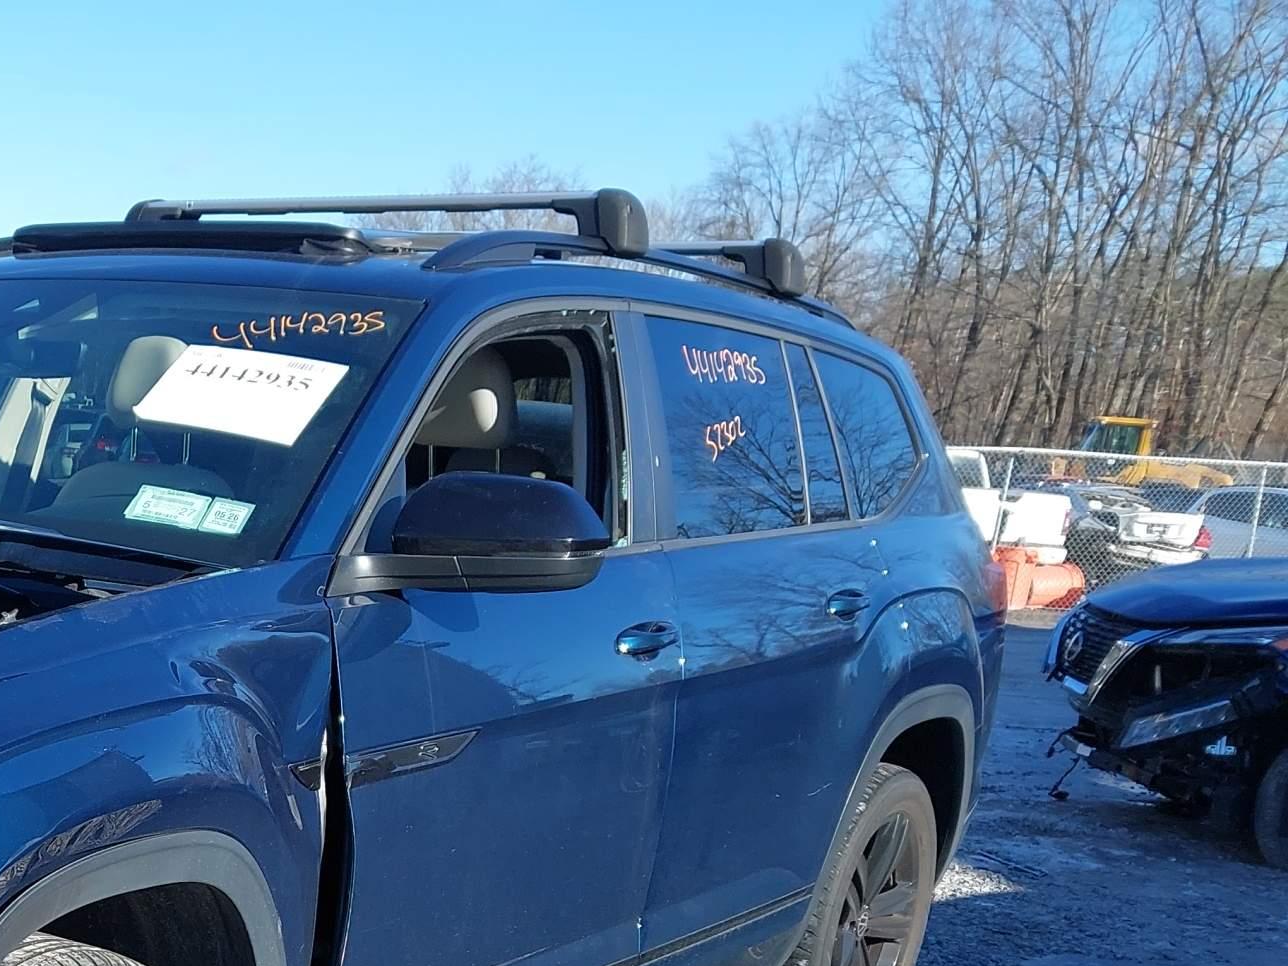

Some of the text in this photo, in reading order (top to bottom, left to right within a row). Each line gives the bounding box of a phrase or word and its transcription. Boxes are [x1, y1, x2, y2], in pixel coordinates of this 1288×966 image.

[211, 311, 386, 349] 44142935
[185, 362, 313, 391] 44142935
[681, 345, 766, 385] 44142935
[705, 415, 746, 464] 52302
